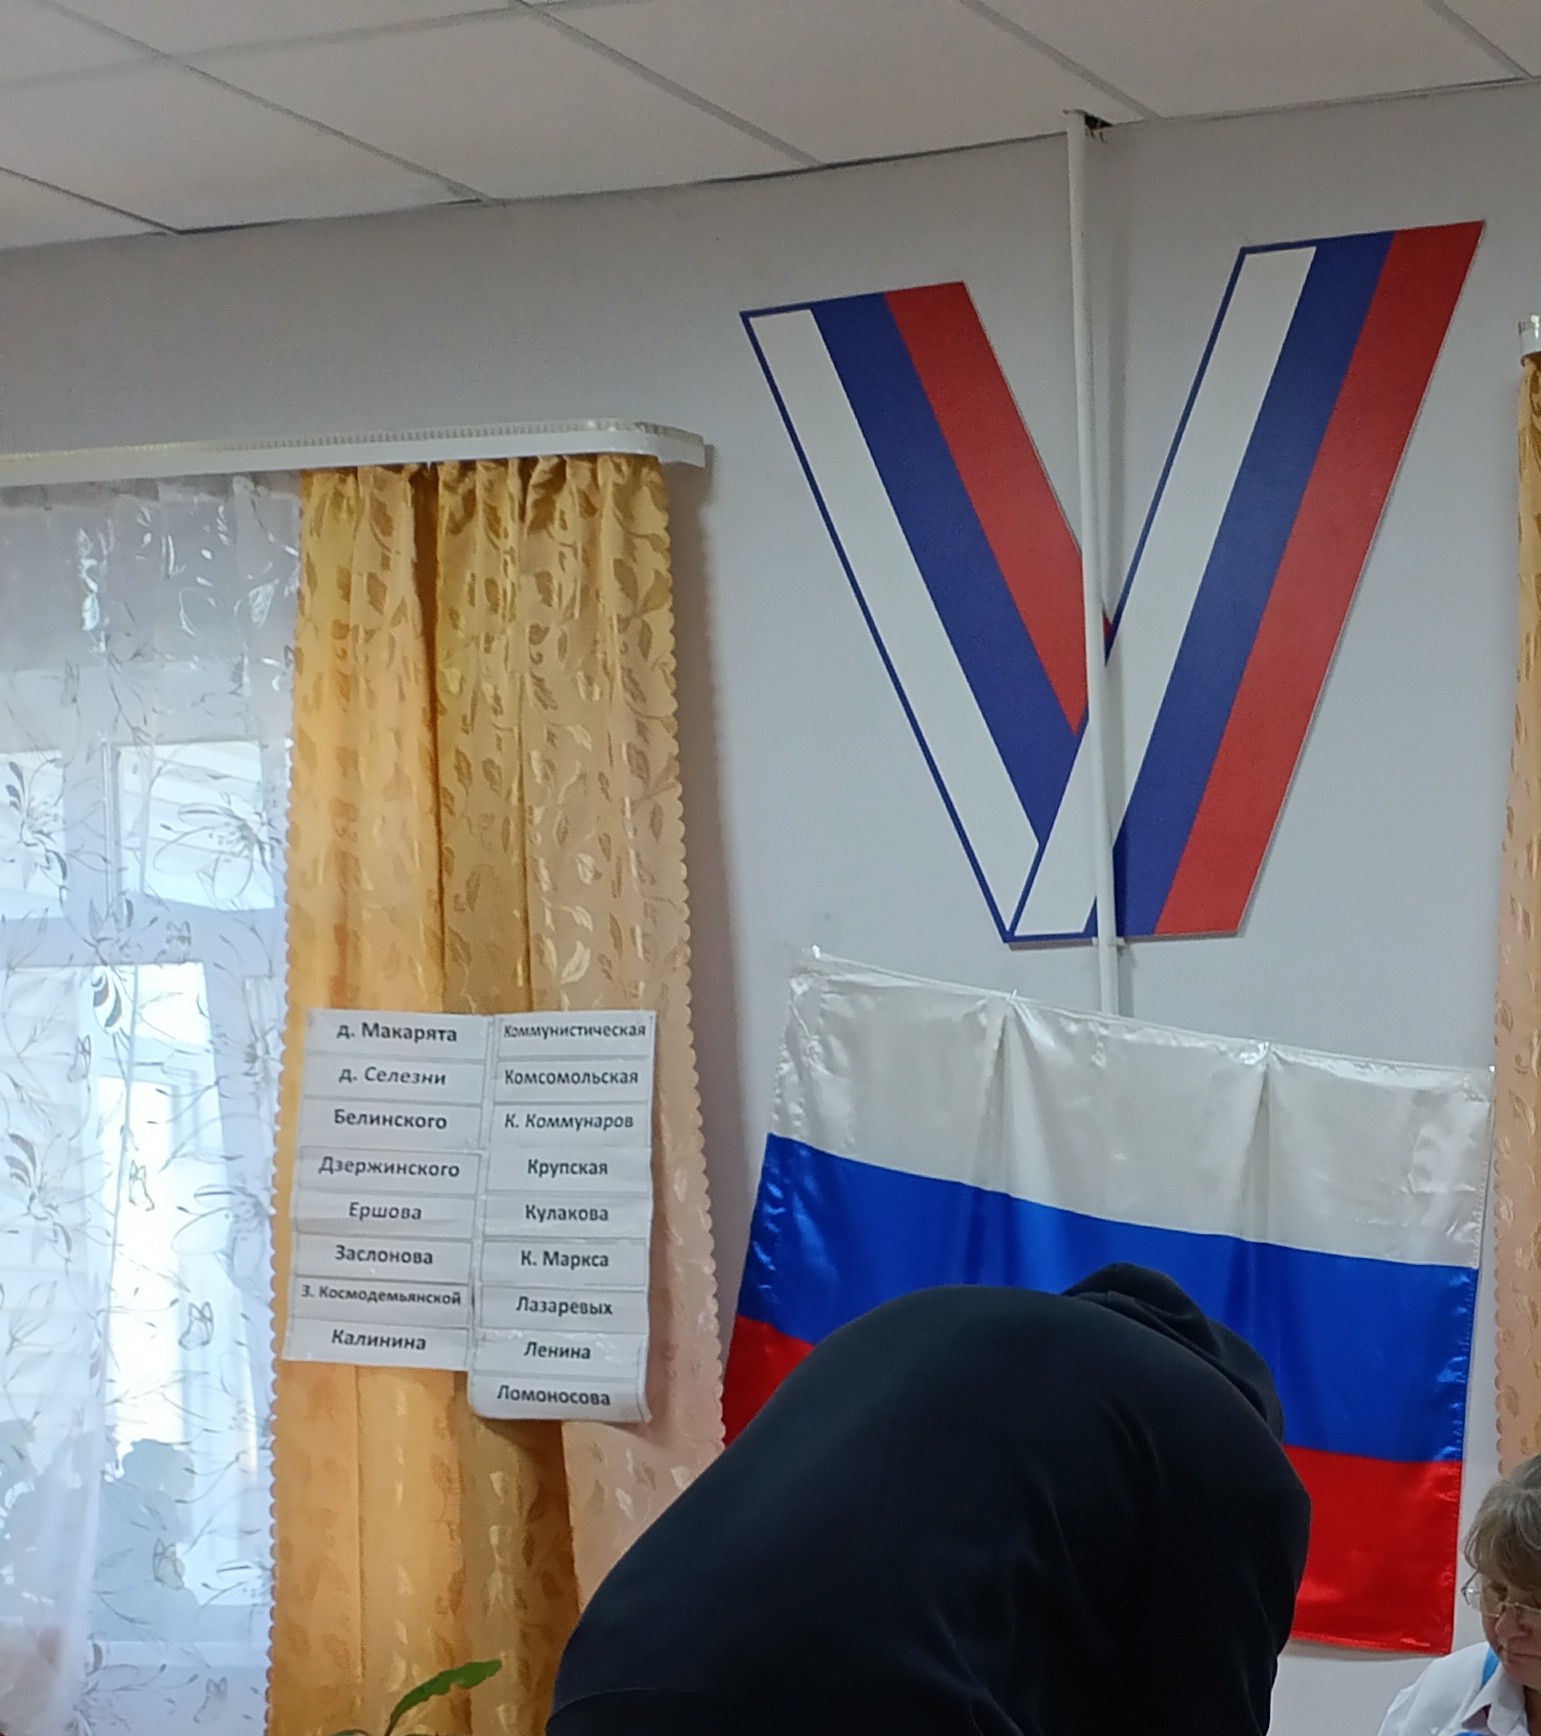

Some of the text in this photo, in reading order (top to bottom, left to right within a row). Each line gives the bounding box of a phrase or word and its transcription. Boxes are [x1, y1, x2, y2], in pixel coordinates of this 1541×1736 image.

[336, 1021, 457, 1044] д. Макарята
[503, 1025, 646, 1040] Коммунистическая
[338, 1066, 446, 1086] д. Селезни
[504, 1069, 639, 1085] Комсомольская
[334, 1108, 448, 1130] Белинского
[504, 1113, 634, 1132] К. Коммунаров
[318, 1155, 460, 1178] Дзержинского
[527, 1158, 608, 1179] Крупская
[348, 1201, 422, 1222] Ершова
[525, 1204, 609, 1223] Кулакова
[335, 1244, 434, 1265] Заслонова
[521, 1249, 609, 1271] К. Маркса
[319, 1286, 462, 1306] Космодемьянской
[516, 1295, 613, 1318] Лазаревых
[331, 1329, 427, 1351] Калинина
[523, 1341, 591, 1360] Ленина
[496, 1384, 612, 1407] Ломоносова
